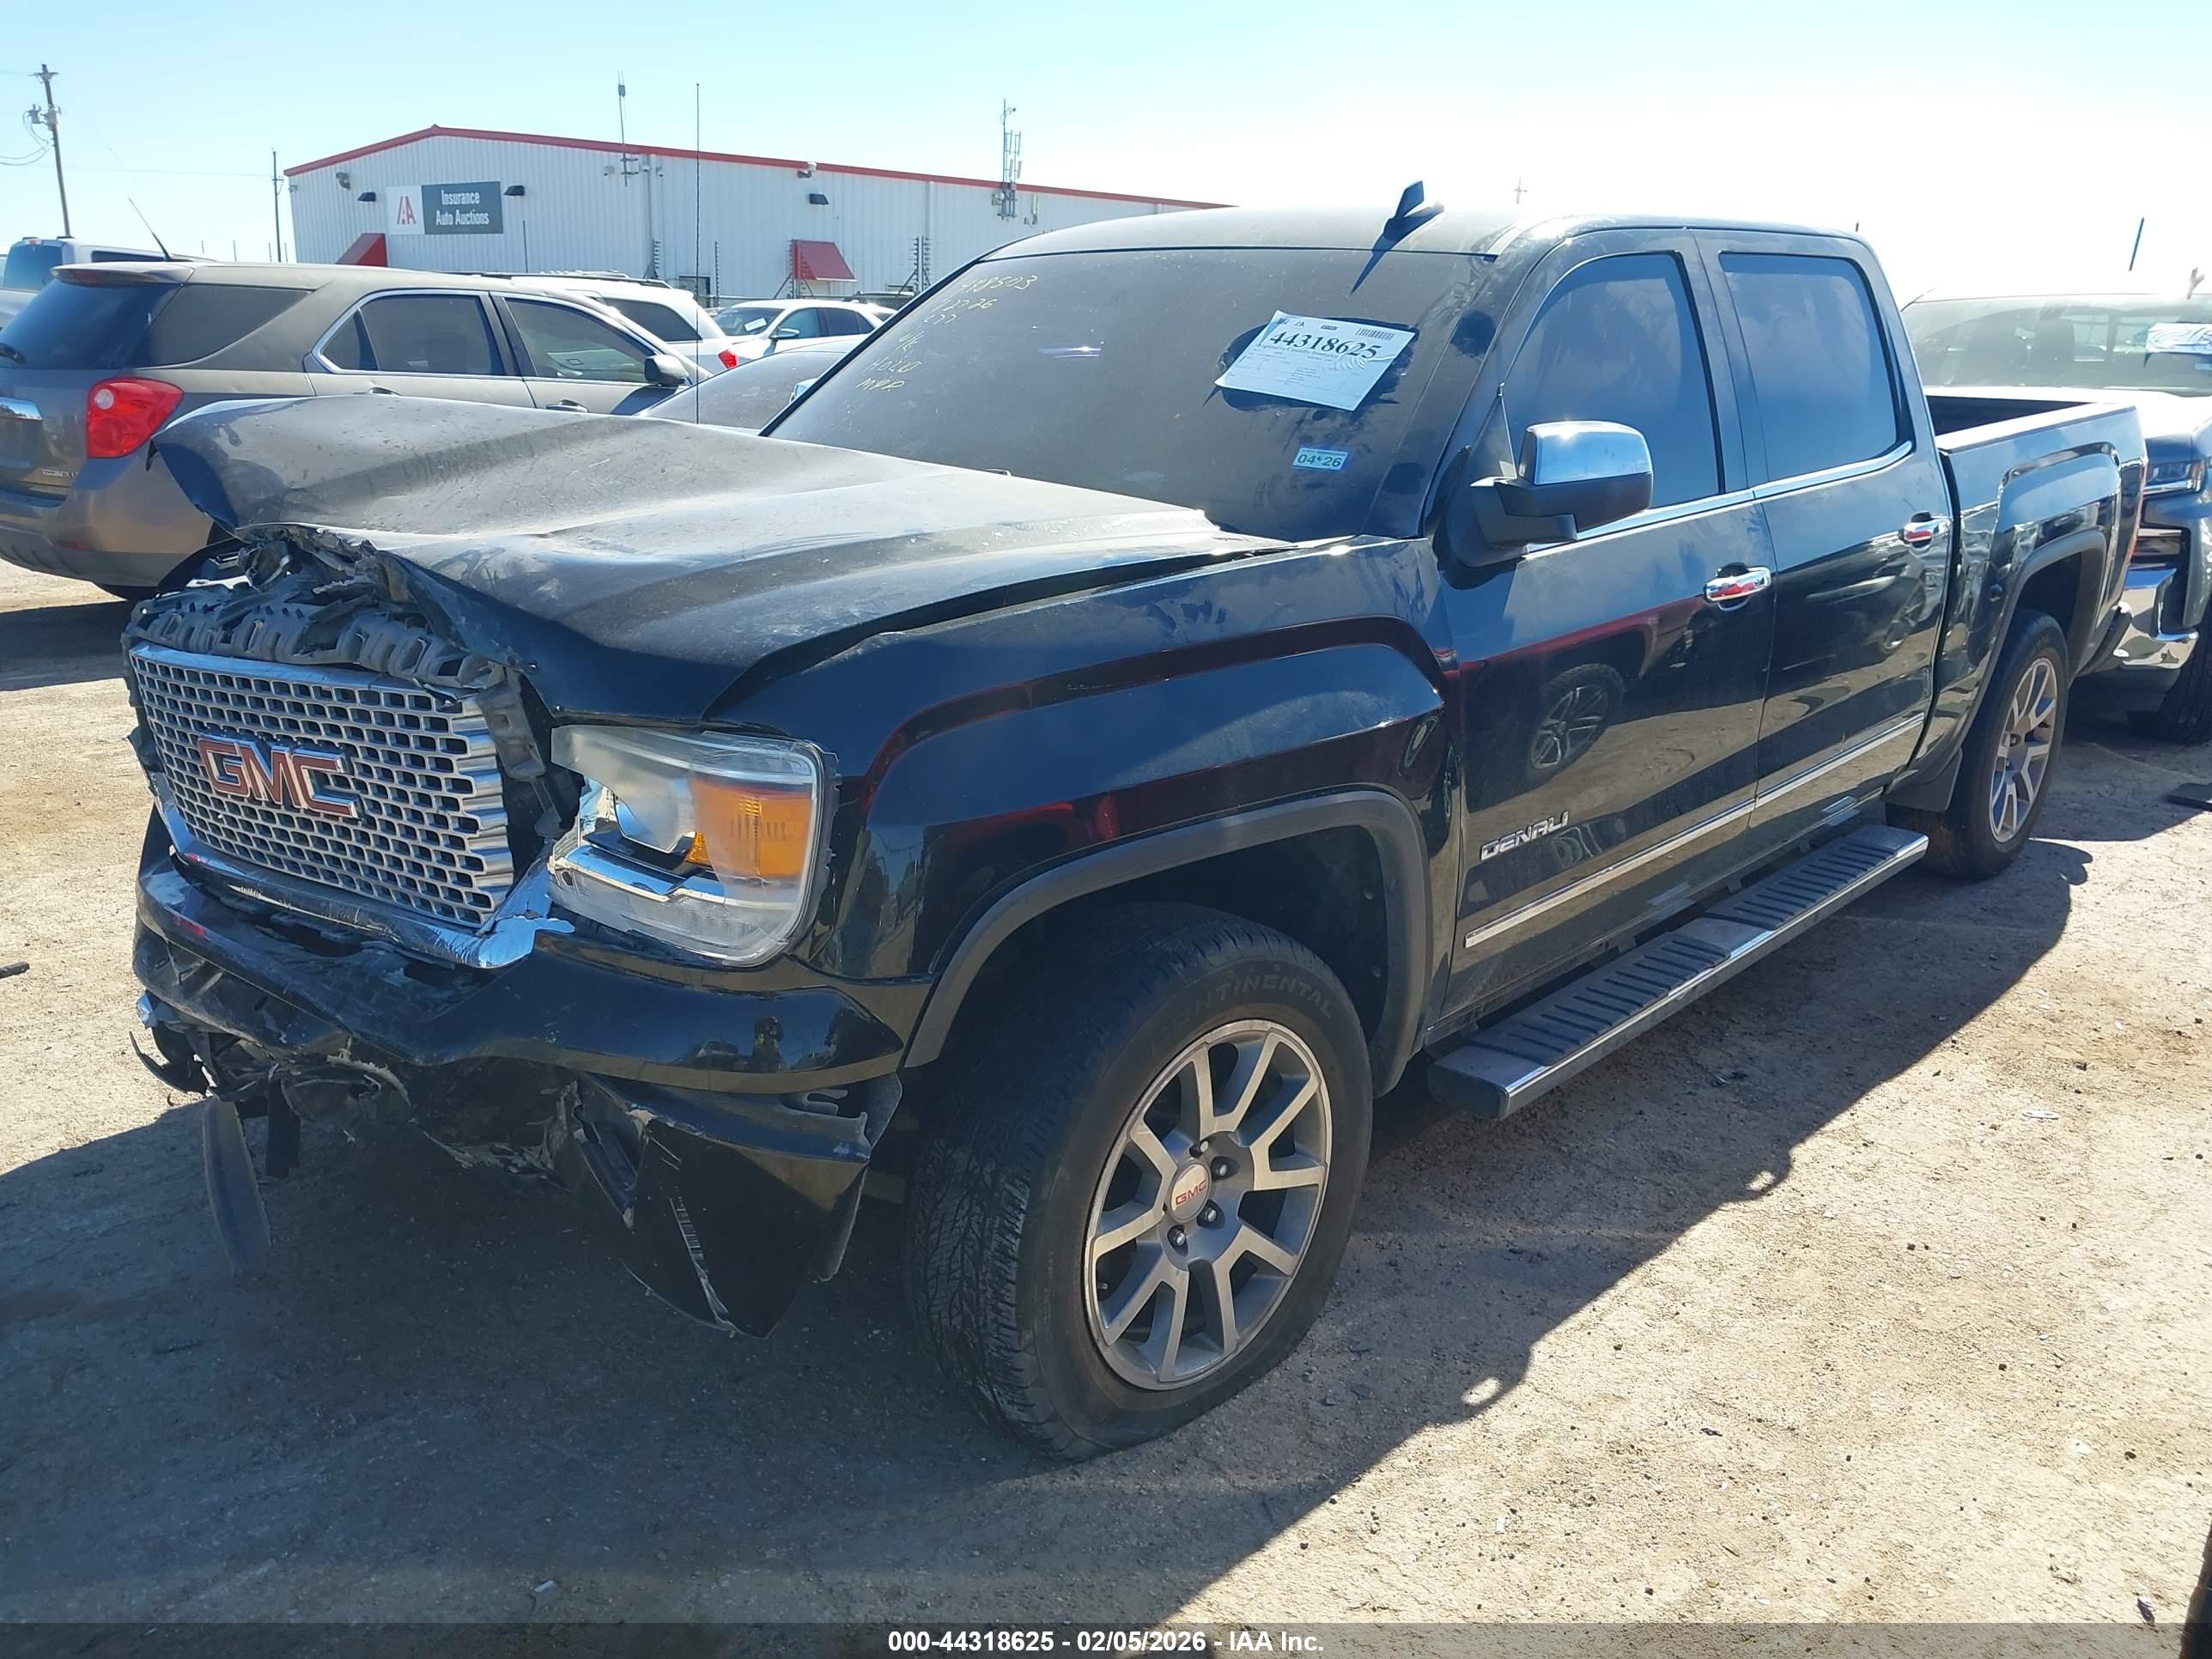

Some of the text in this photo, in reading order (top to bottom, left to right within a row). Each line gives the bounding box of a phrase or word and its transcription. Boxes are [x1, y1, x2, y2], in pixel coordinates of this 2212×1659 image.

[441, 189, 480, 205] Insurance
[435, 209, 489, 226] Auto Auctions
[1270, 331, 1382, 359] 44318625
[1297, 454, 1342, 467] 04 26
[198, 734, 357, 818] GMC
[1480, 811, 1569, 861] DENALI
[1175, 1179, 1207, 1206] GMC
